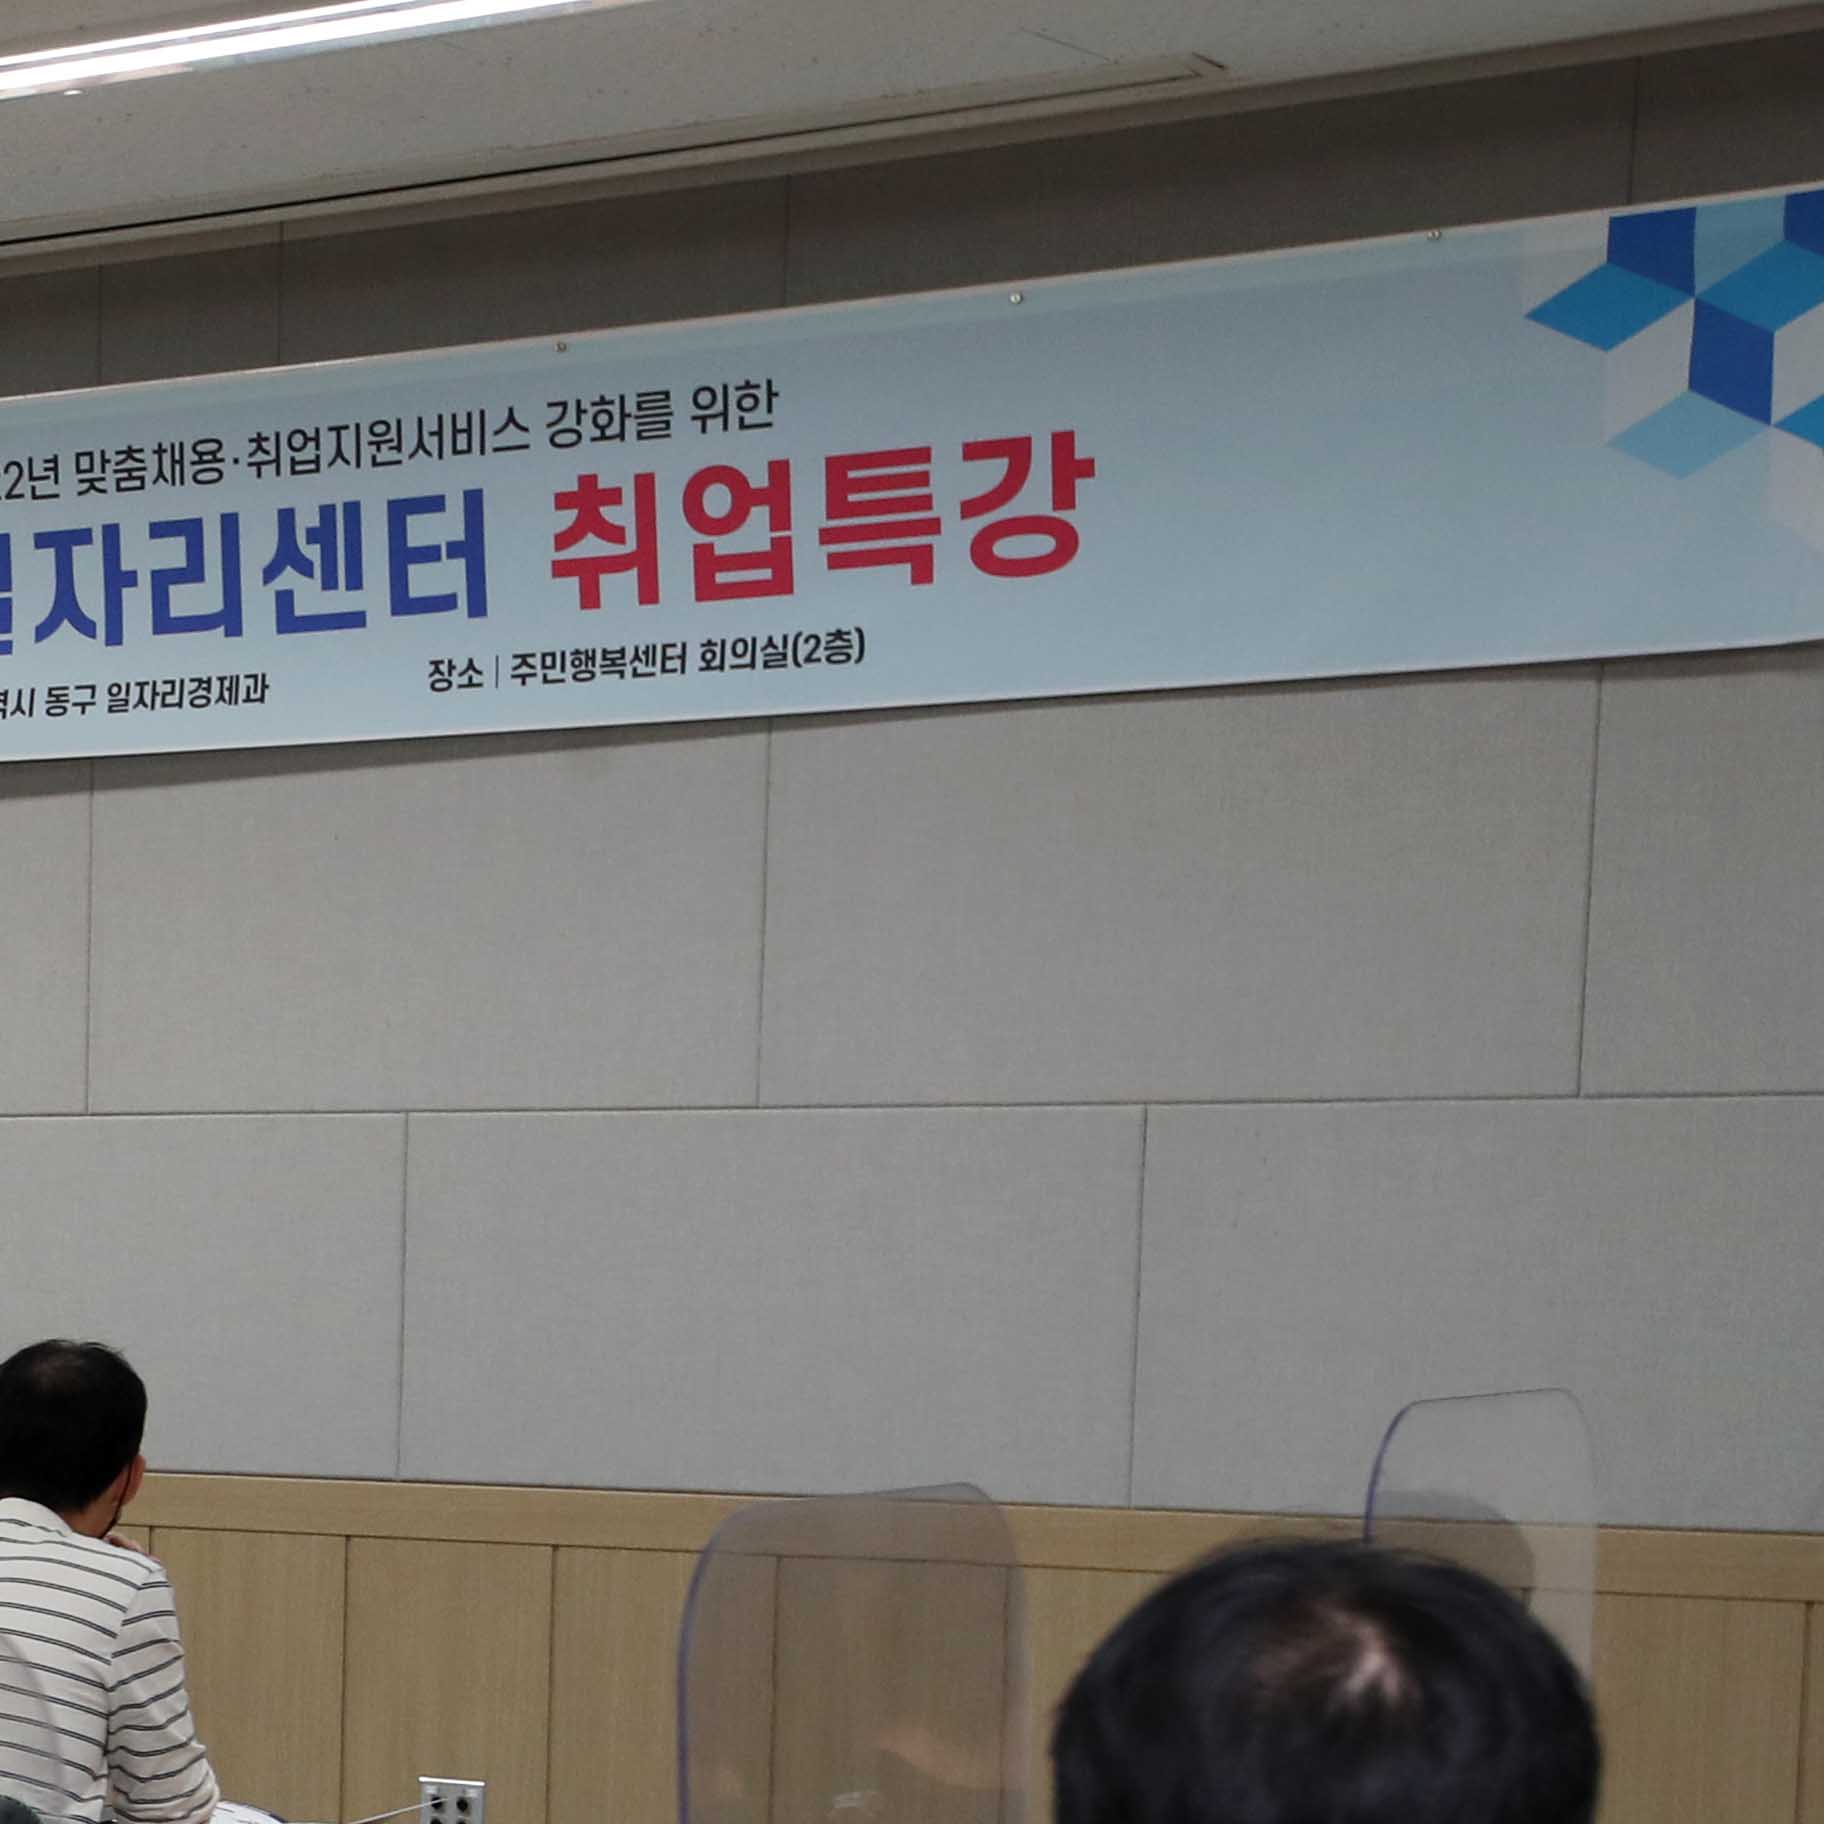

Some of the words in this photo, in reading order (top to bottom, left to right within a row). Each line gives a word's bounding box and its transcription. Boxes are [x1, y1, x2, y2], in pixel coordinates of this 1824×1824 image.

[545, 389, 675, 450] 강화를
[690, 377, 780, 435] 위한
[551, 430, 1095, 610] 취업특강
[45, 684, 97, 717] 동구
[107, 672, 270, 714] 일자리경제과
[428, 657, 484, 693] 장소
[510, 641, 687, 687] 주민행복센터
[698, 626, 866, 673] 회의실(2층)
